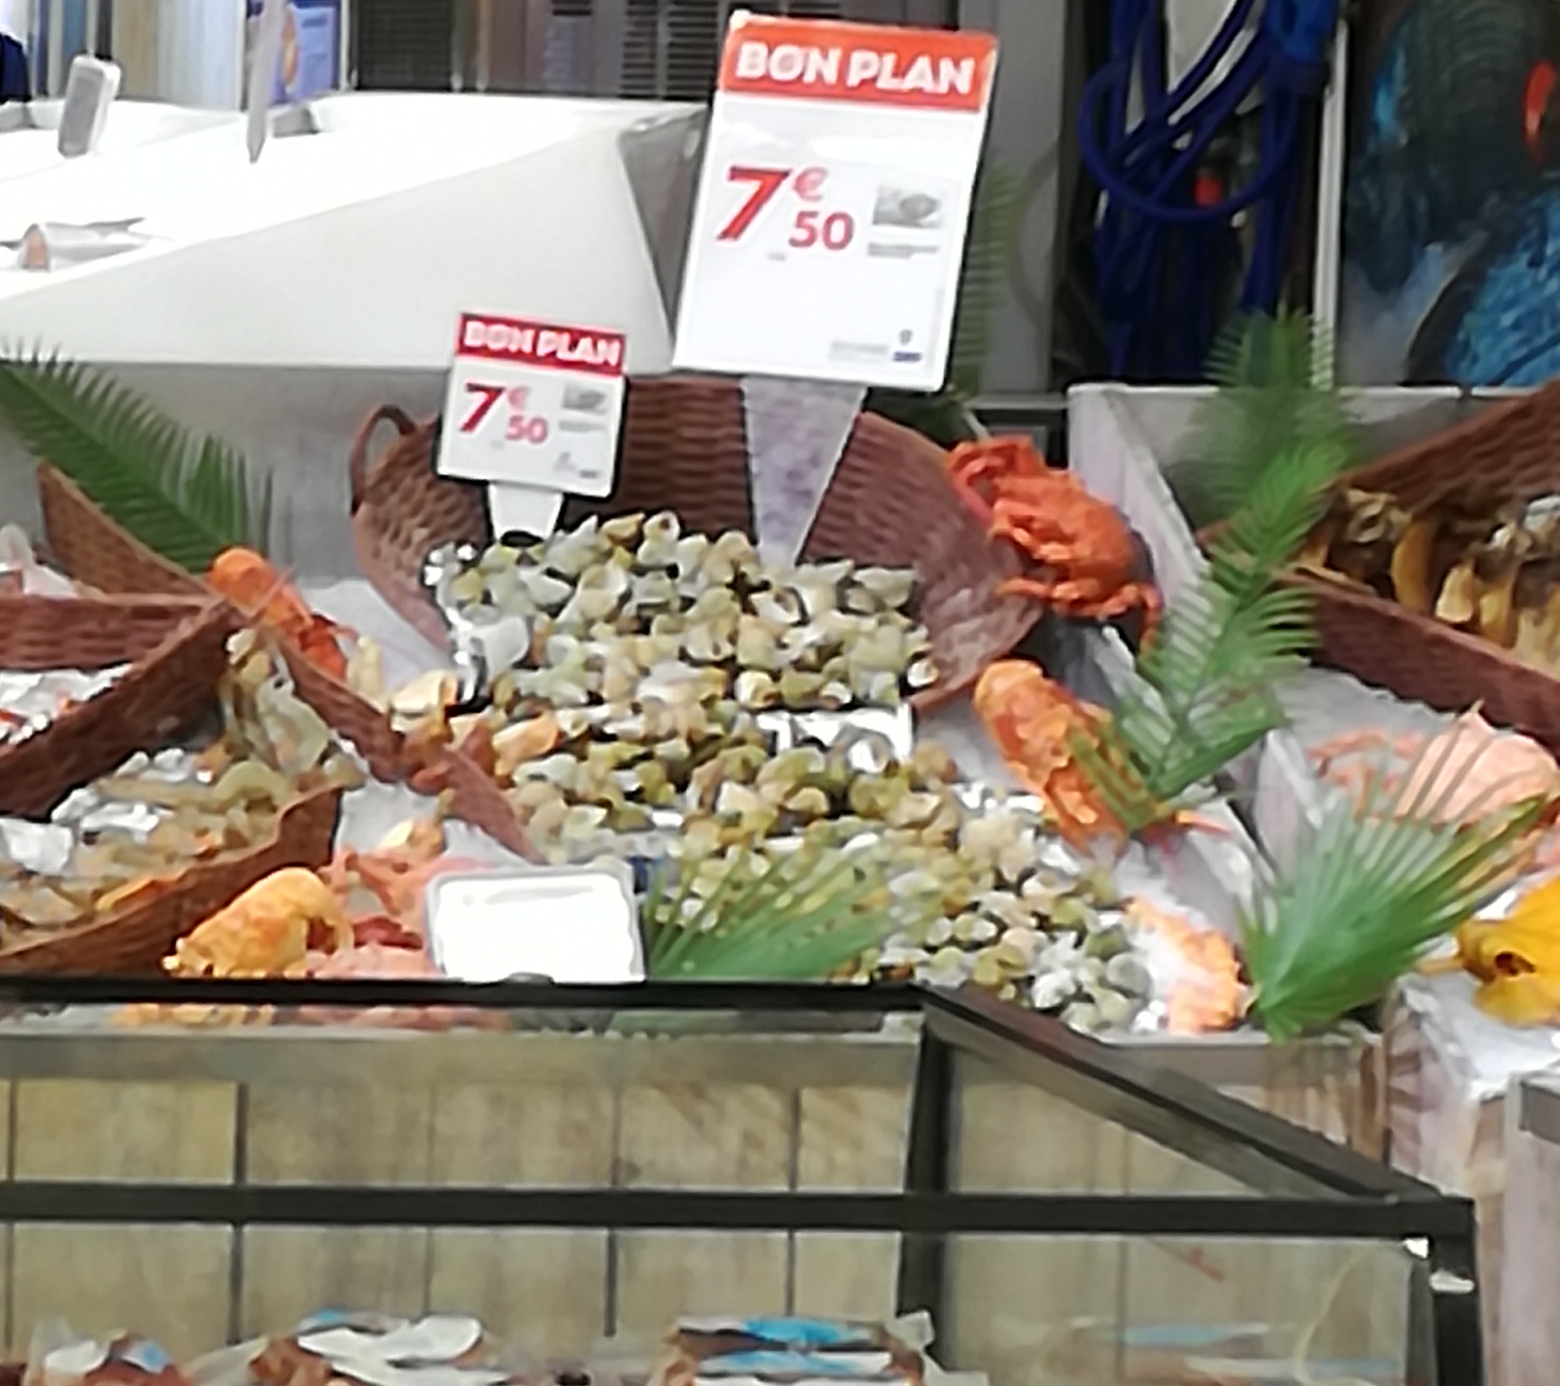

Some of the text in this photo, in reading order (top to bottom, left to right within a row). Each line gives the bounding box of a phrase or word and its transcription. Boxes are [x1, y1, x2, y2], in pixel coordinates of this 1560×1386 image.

[736, 42, 975, 94] BON PLAN
[464, 320, 621, 367] BON PLAN
